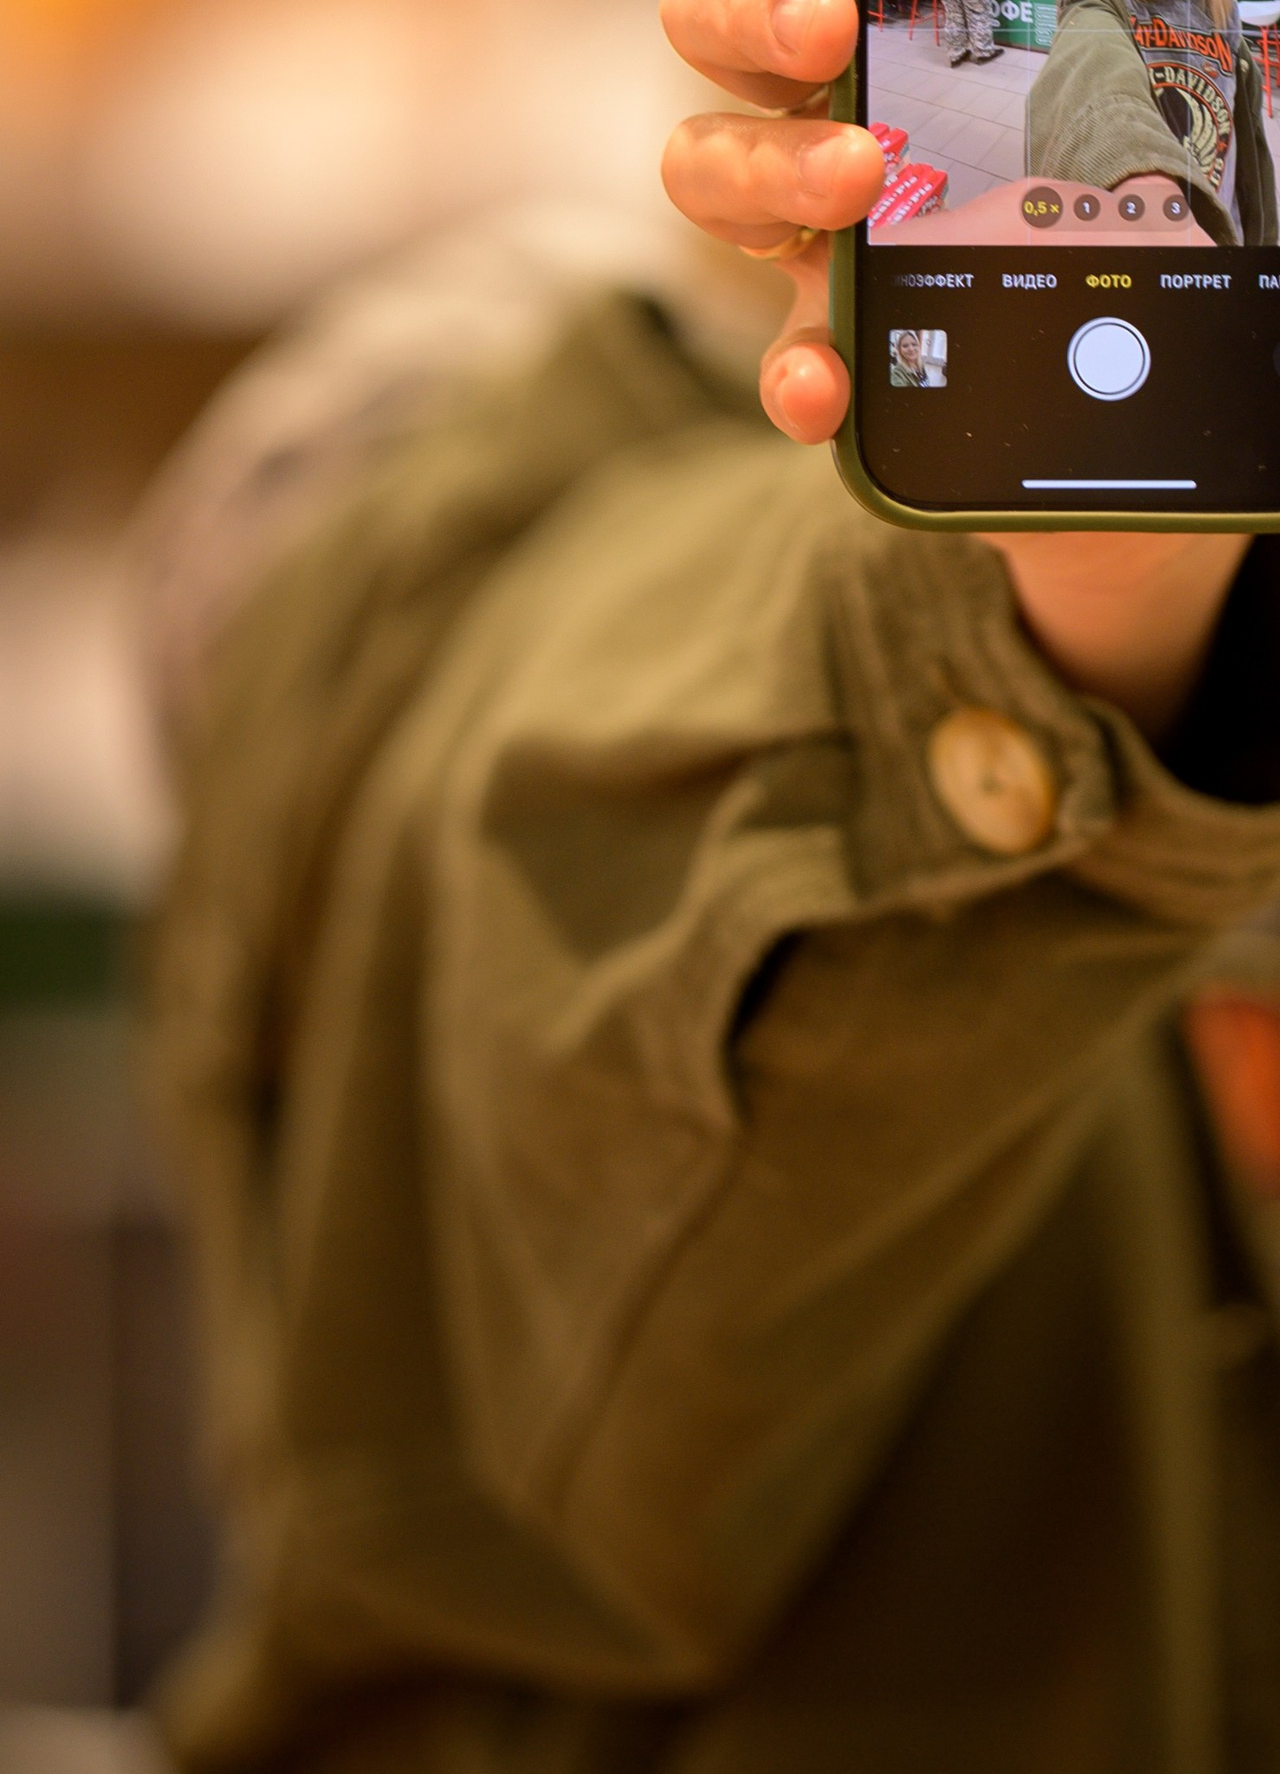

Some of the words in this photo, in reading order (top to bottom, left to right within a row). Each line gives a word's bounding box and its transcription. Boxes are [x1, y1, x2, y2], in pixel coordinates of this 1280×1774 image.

[1082, 201, 1090, 214] 1
[1126, 201, 1136, 214] 2
[1170, 201, 1181, 214] 3
[1001, 273, 1058, 290] ВИДЕО
[1085, 273, 1133, 289] ФОТО
[1160, 273, 1232, 290] ПОРТРЕТ
